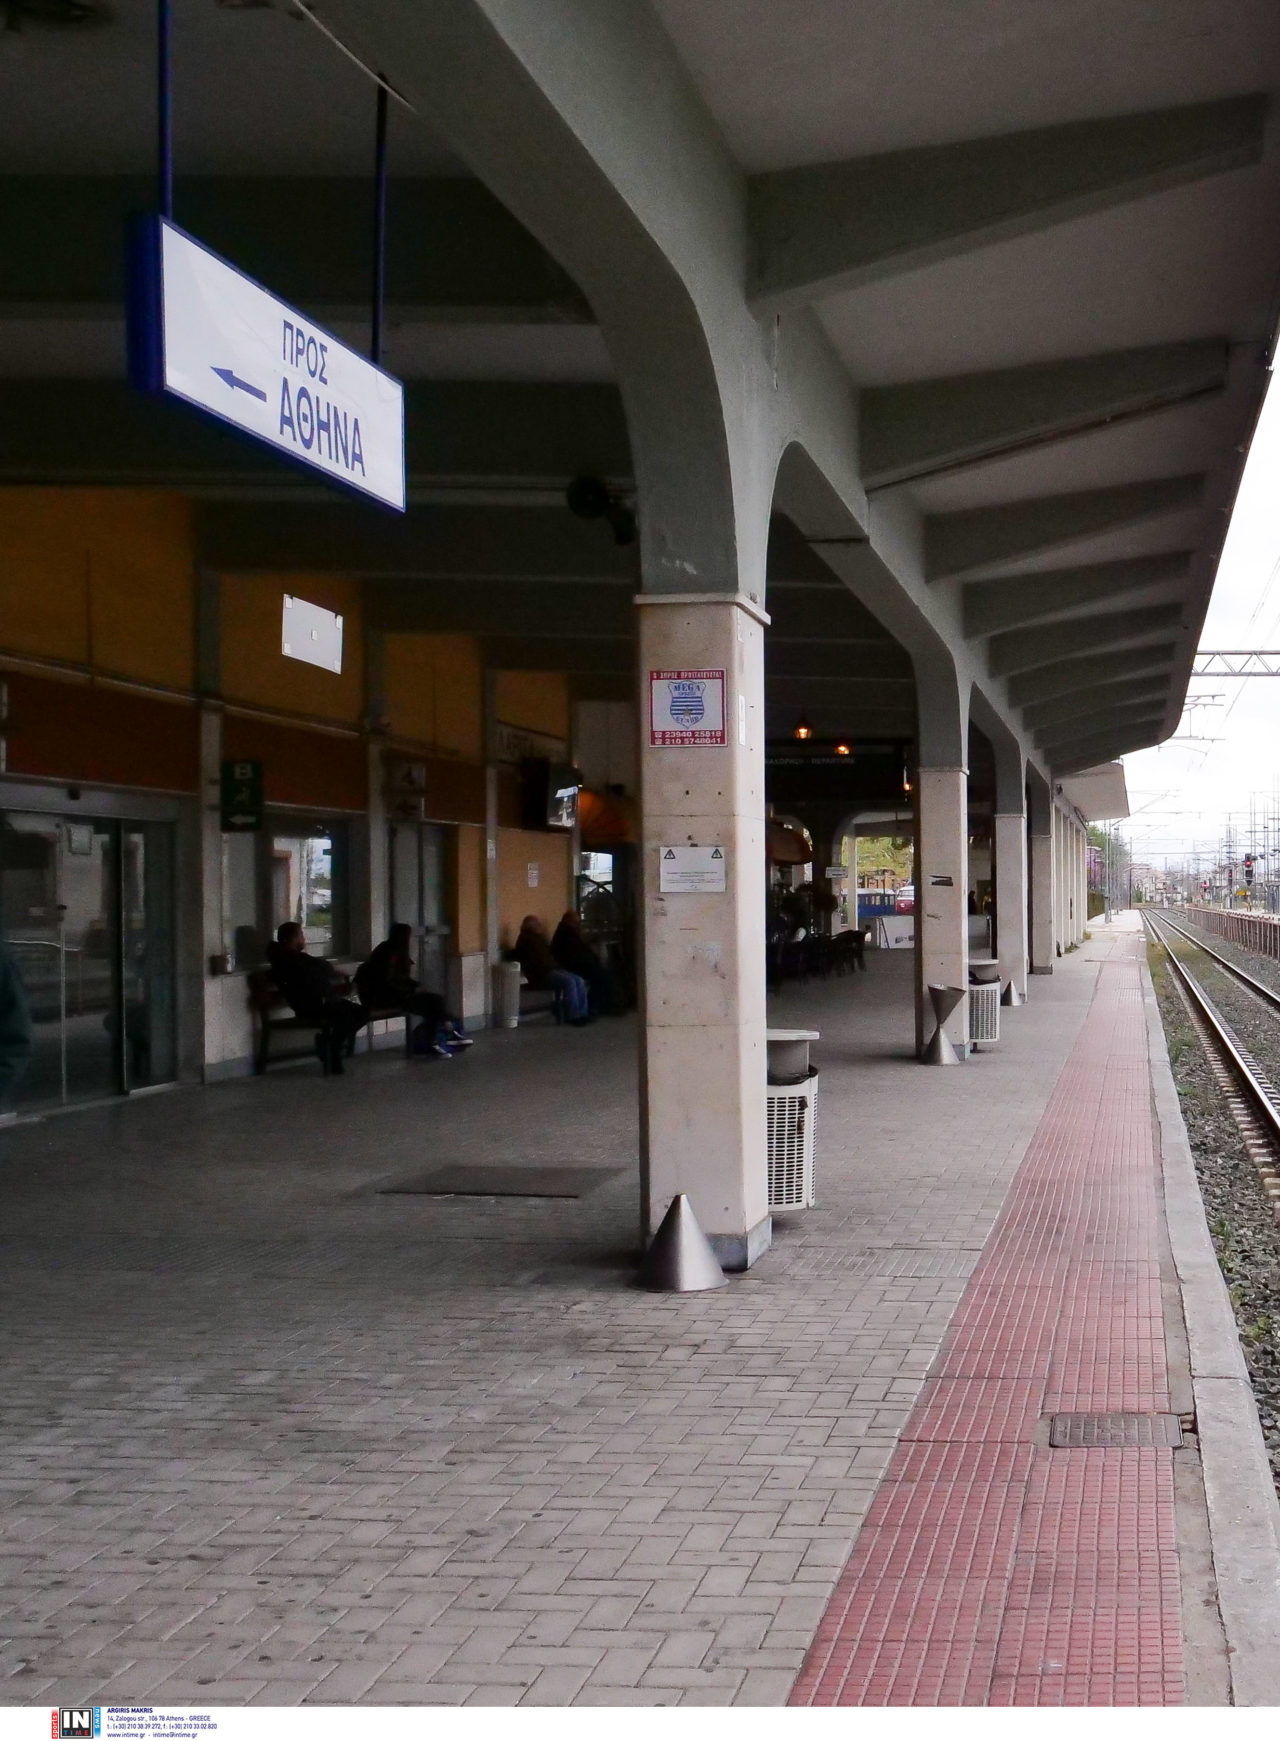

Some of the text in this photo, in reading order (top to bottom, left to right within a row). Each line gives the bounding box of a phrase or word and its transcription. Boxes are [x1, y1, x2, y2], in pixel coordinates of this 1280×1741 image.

[283, 319, 329, 386] ΠΡΟΣ
[279, 376, 365, 477] ΑΘΗΝΑ
[674, 683, 700, 691] MEGA
